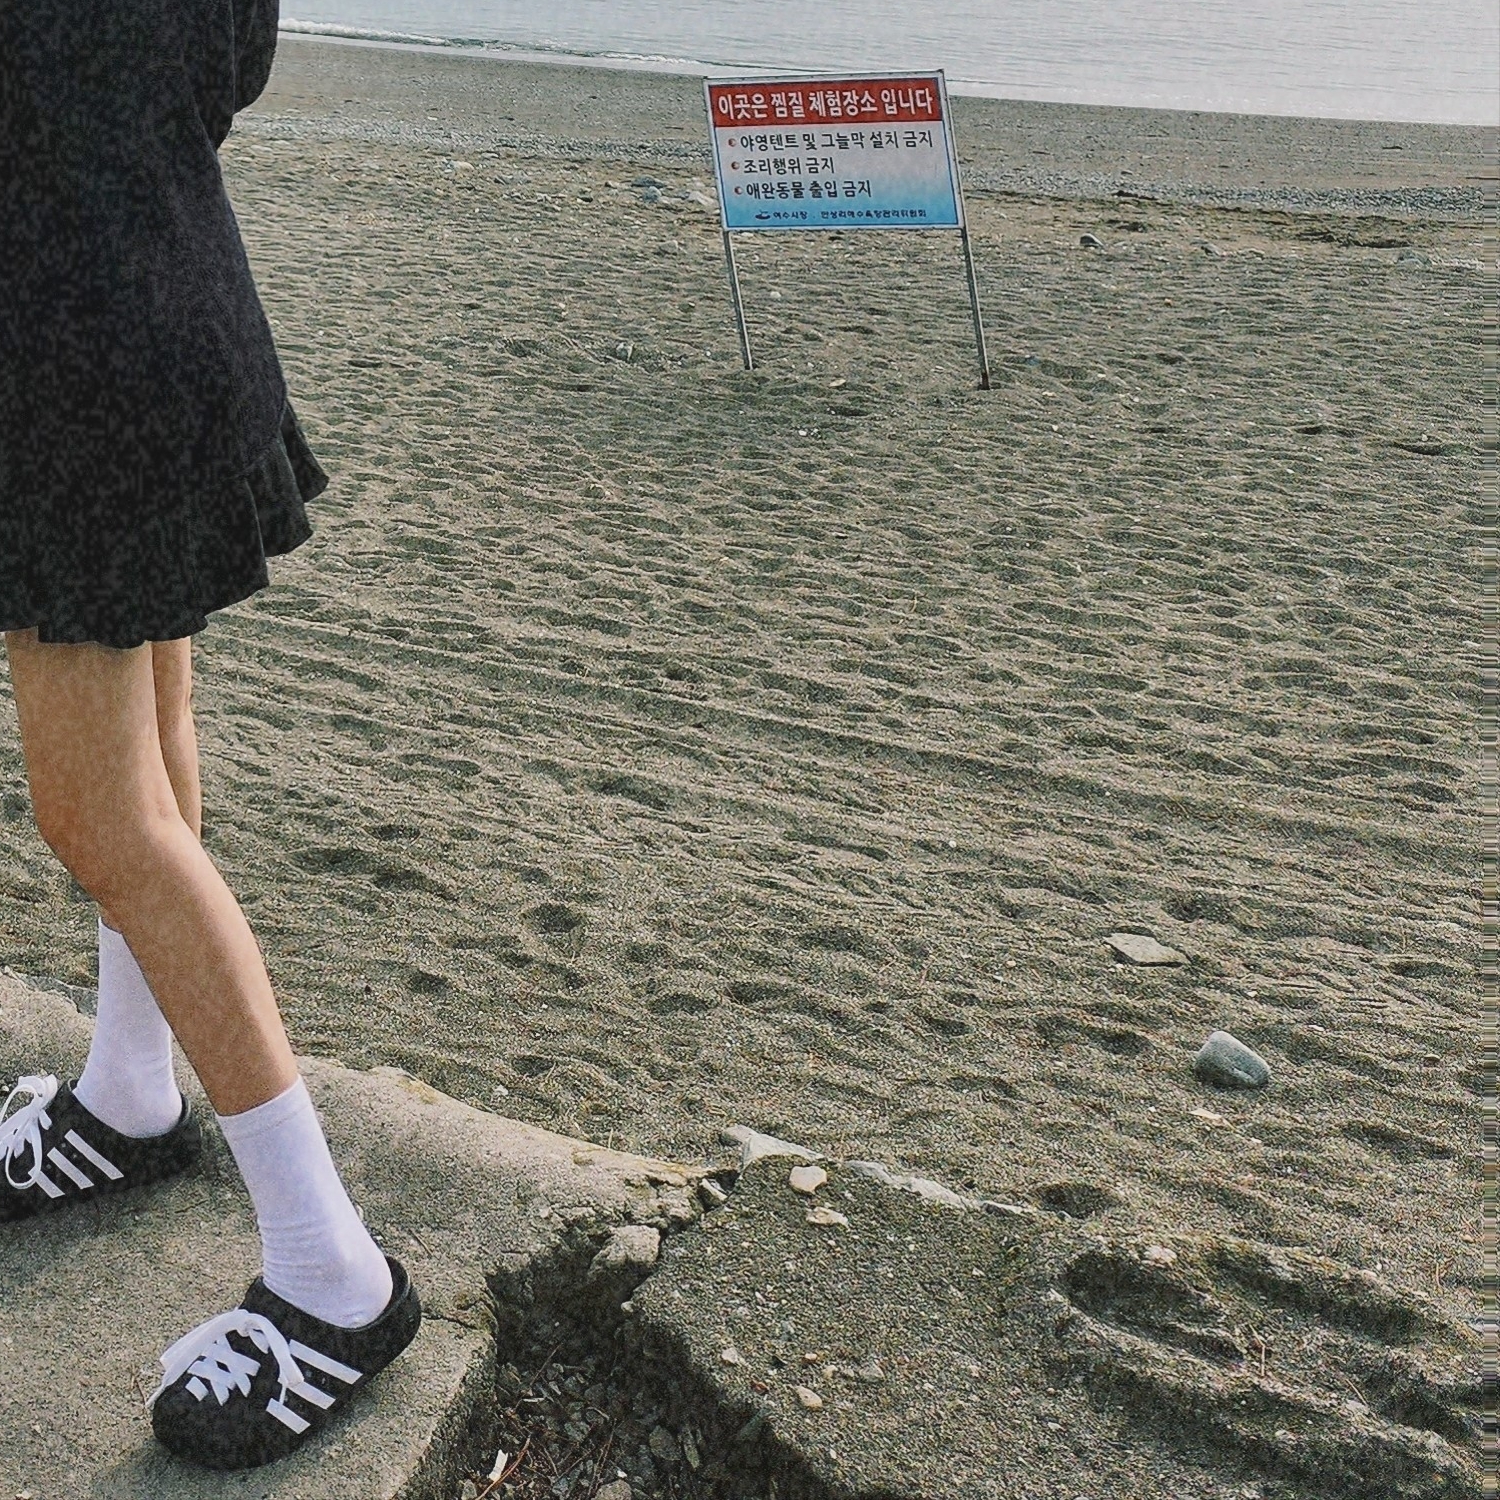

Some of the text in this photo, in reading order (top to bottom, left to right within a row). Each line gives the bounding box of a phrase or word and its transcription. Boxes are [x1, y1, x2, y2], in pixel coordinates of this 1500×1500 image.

[718, 87, 933, 120] 이곳은 찜질 체험장소 입니다
[740, 129, 933, 152] 야영텐트 및 그늘막 설치 금지
[743, 156, 835, 176] 조리행위 금지
[746, 179, 872, 199] 애완동물 출입 금지
